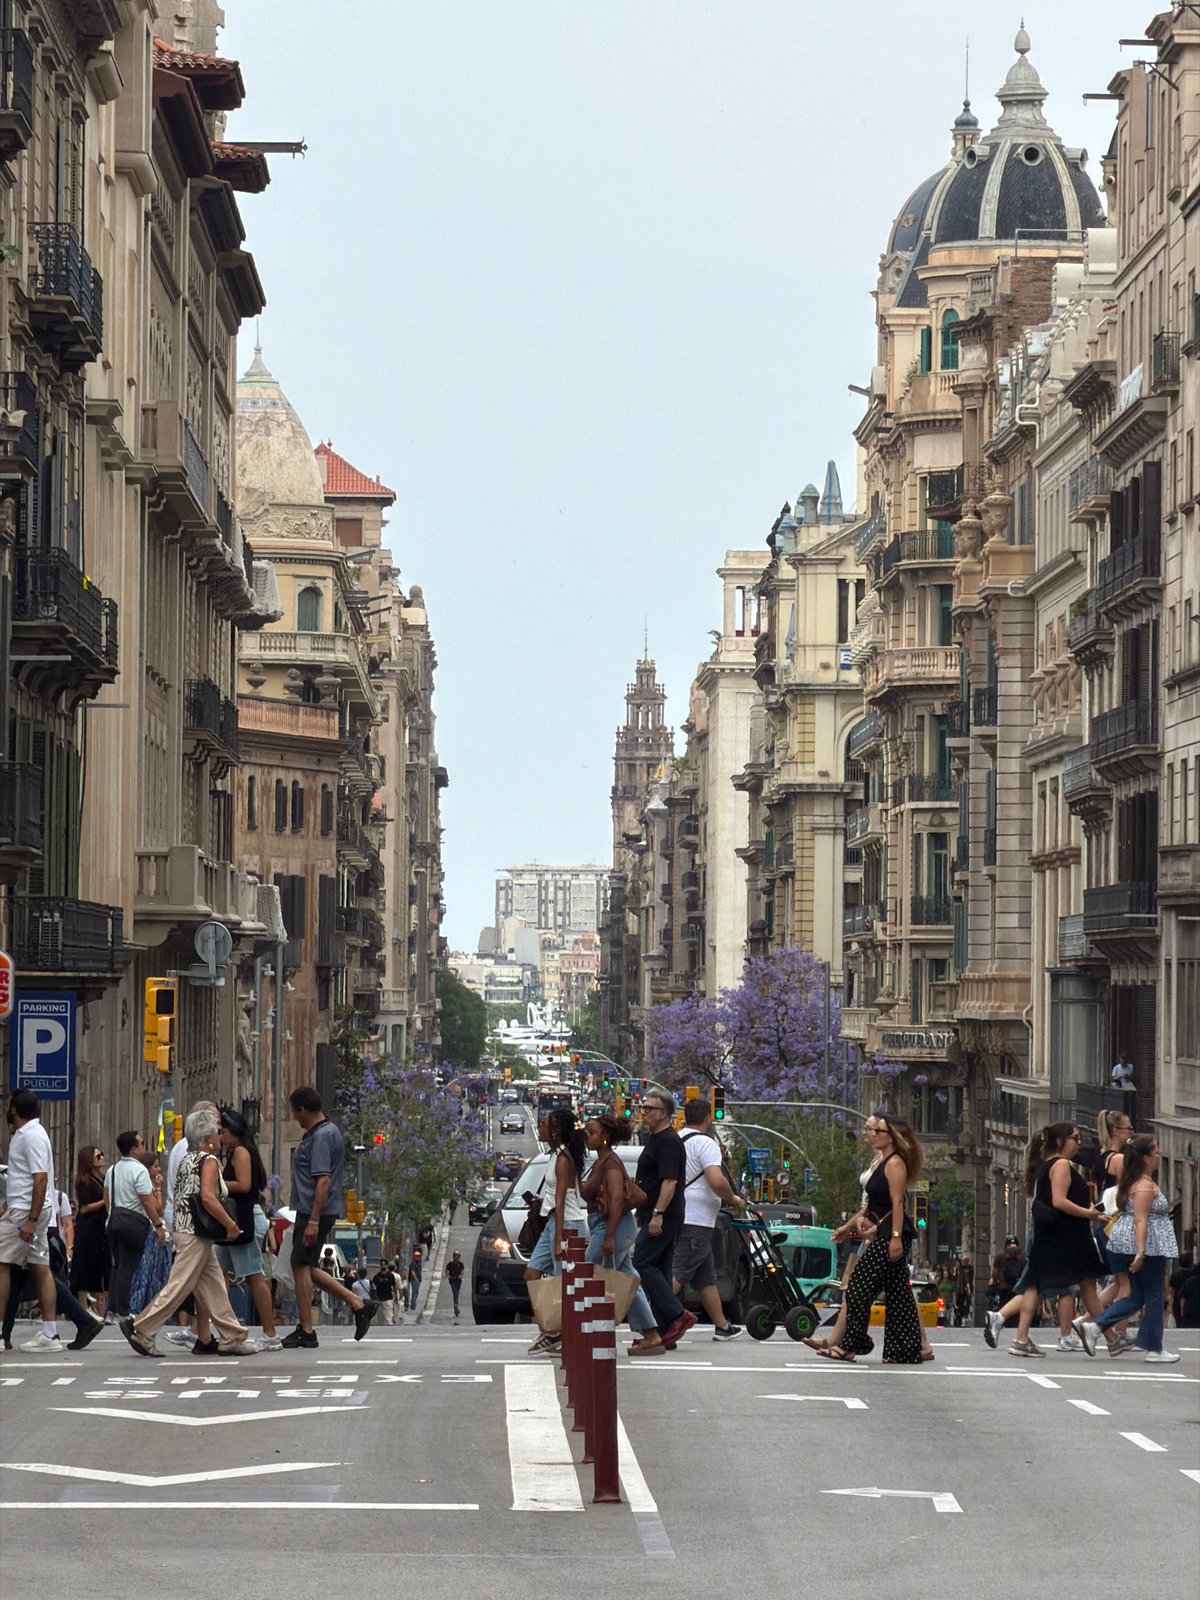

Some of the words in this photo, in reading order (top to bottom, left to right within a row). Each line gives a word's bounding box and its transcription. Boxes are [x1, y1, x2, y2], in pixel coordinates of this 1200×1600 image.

[23, 1004, 66, 1012] PARKING
[23, 1018, 66, 1073] P
[84, 1388, 355, 1399] BUS
